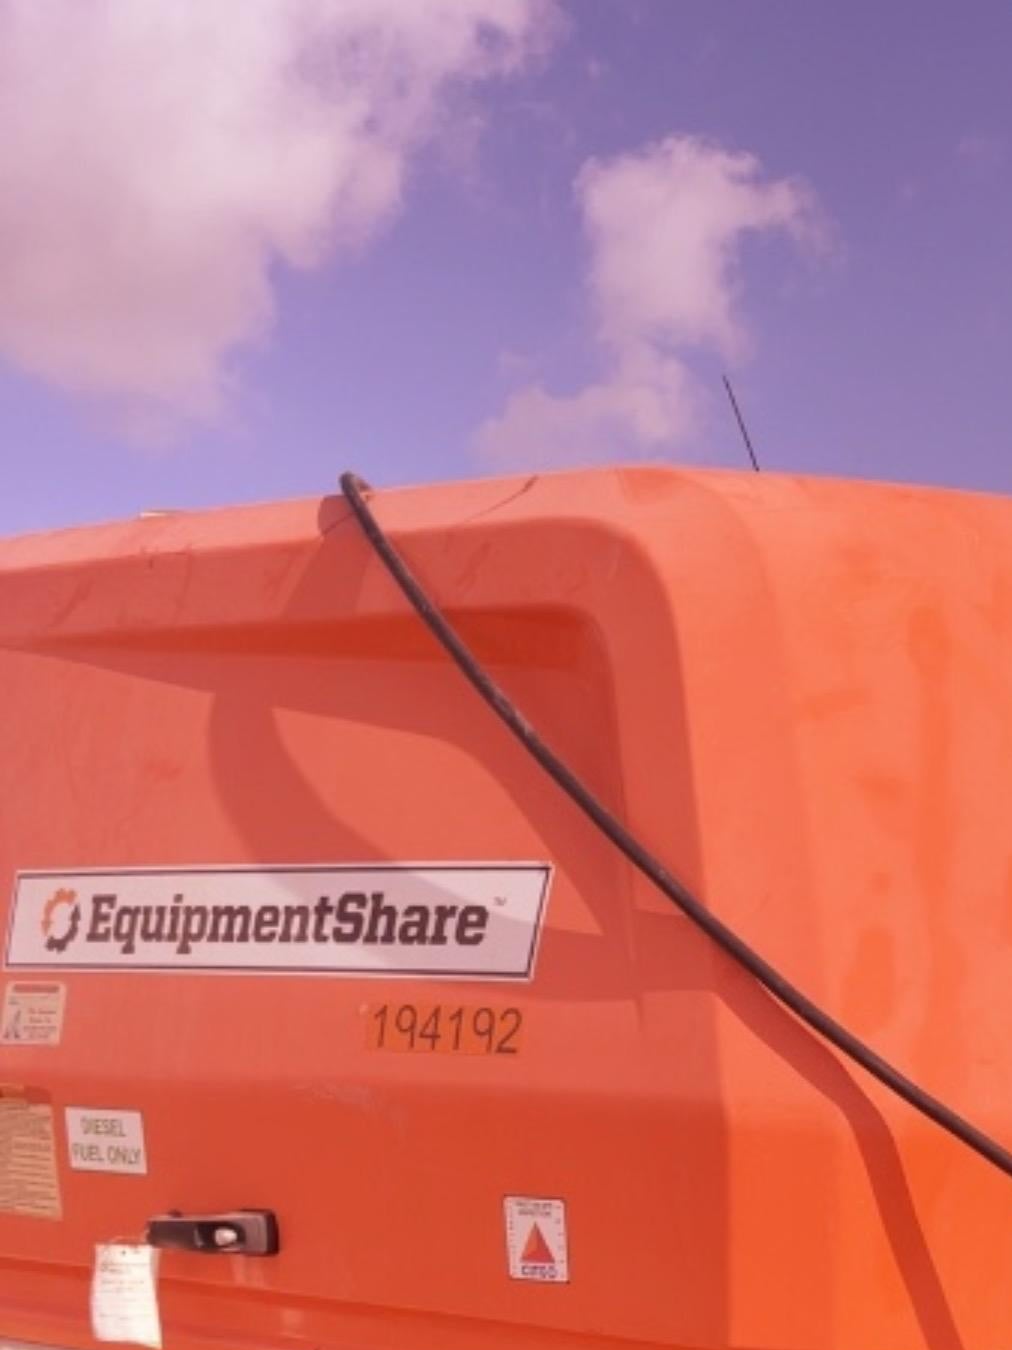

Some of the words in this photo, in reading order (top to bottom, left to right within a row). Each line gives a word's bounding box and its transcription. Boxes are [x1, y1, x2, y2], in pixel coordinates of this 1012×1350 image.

[87, 892, 489, 954] EquipmentShare
[373, 1003, 523, 1055] 194192
[80, 1116, 127, 1138] DIESEL
[72, 1143, 105, 1162] FUEL
[107, 1145, 141, 1166] ONLY
